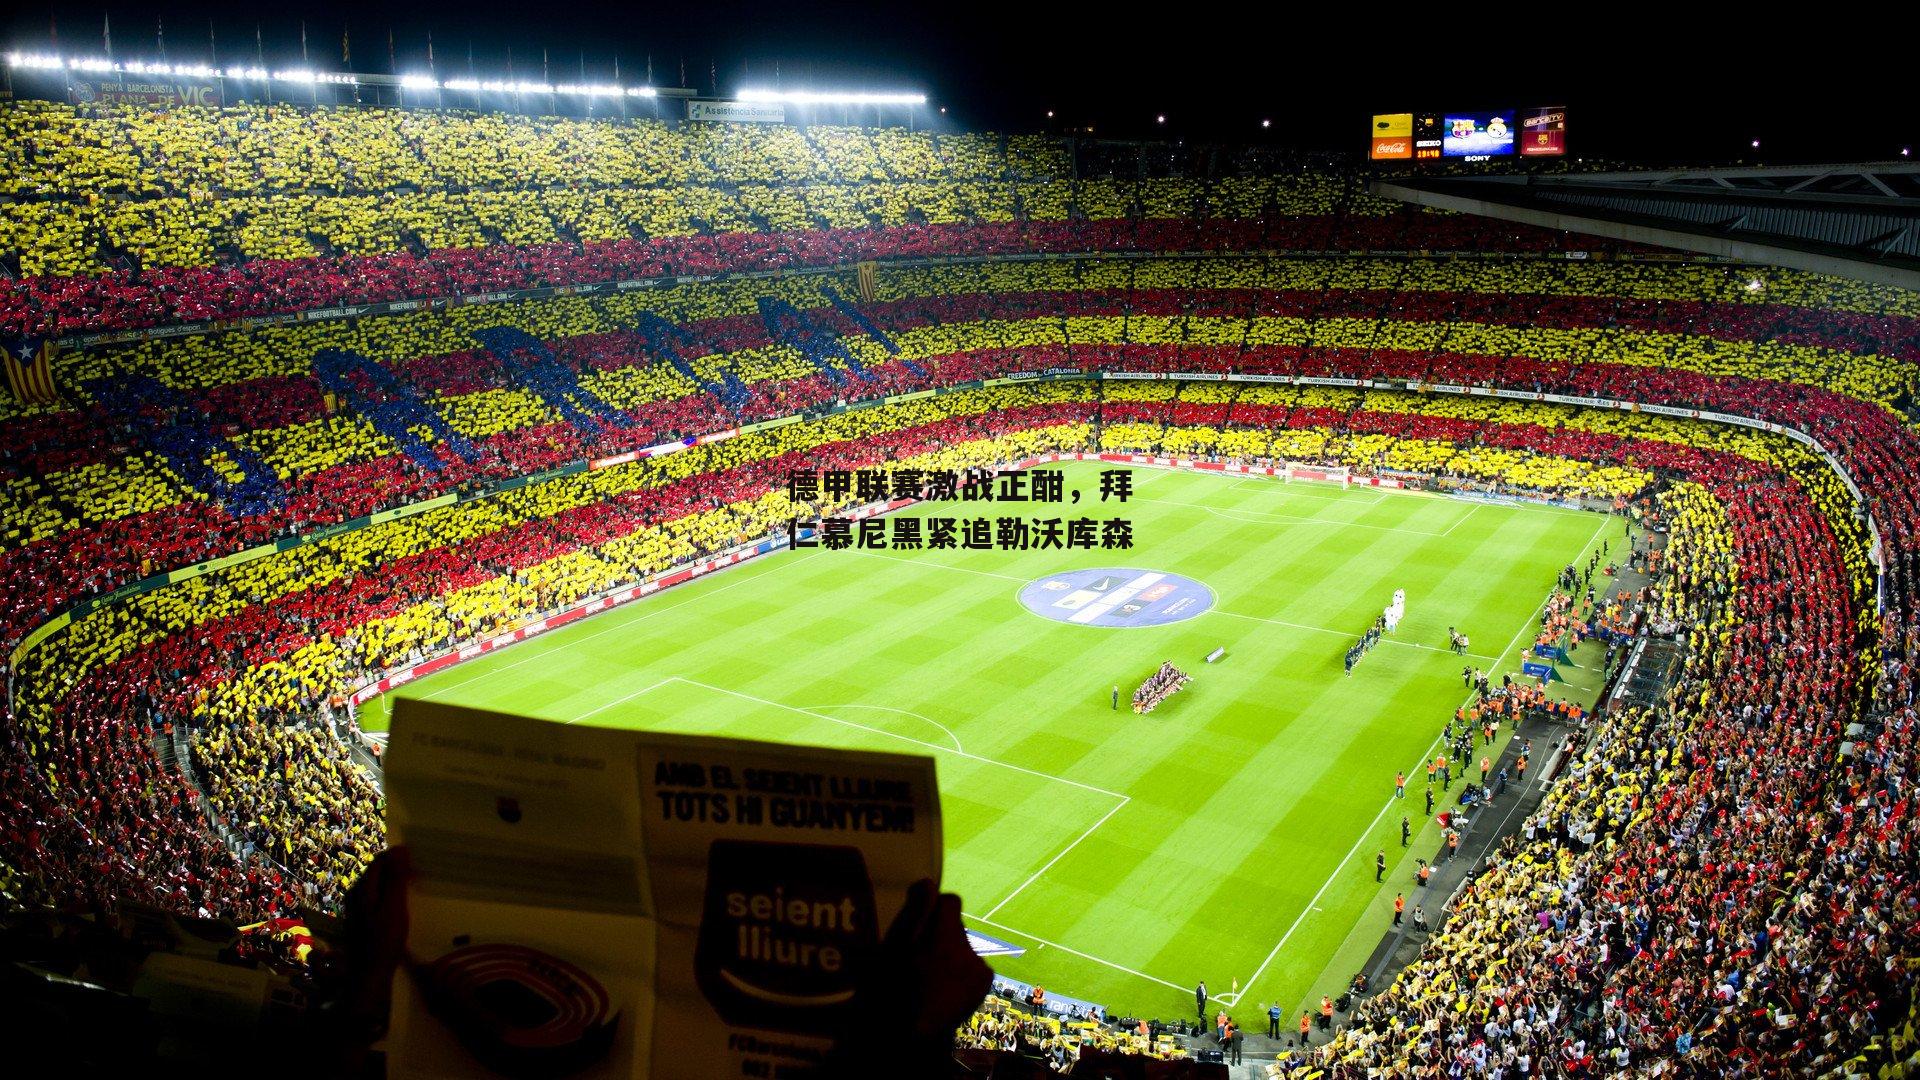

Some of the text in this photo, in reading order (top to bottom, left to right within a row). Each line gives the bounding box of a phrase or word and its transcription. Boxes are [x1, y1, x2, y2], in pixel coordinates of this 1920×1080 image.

[101, 83, 174, 94] PENYA BARCELONISTA
[101, 85, 215, 107] PLANA DE VIC
[307, 307, 357, 320] NIKEFOOTBALL.COM
[1007, 371, 1038, 380] FREEDOM
[1043, 367, 1080, 376] CATALONIA
[1661, 408, 1689, 416] AIRLINES
[1714, 414, 1763, 428] TURKISH AIRLINES
[655, 761, 911, 803] AMB EL SEIENT LLIURE
[655, 790, 730, 824] TOTS
[735, 794, 763, 826] HI
[725, 885, 856, 934] seient
[738, 923, 844, 974] lliure
